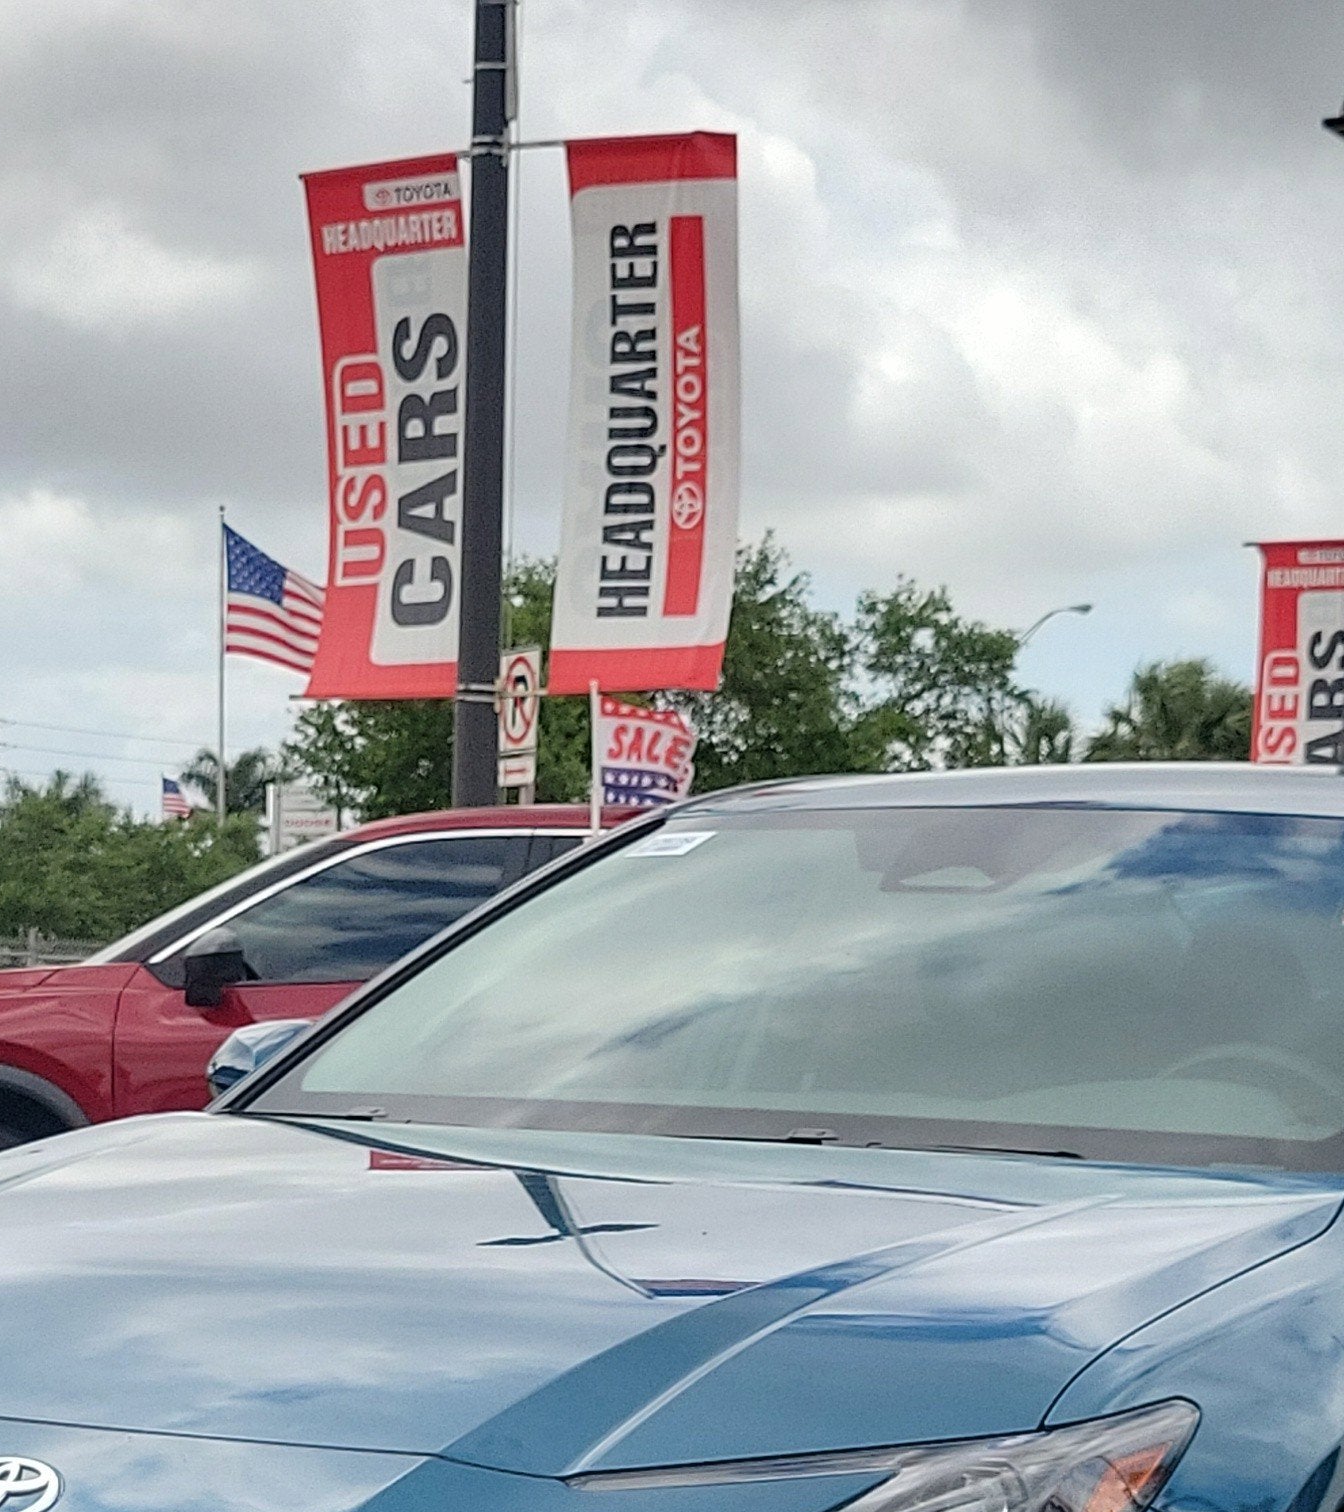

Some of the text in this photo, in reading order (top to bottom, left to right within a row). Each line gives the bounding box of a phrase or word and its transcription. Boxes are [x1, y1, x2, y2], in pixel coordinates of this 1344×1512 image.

[322, 209, 457, 255] HEADQUARTER
[394, 182, 451, 204] TOYOTA
[597, 220, 667, 618] HEADQUARTER
[676, 325, 703, 479] TOYOTA
[339, 359, 387, 581] USED
[392, 312, 459, 627] CARS
[608, 724, 691, 770] SALE
[1262, 655, 1299, 764] SED
